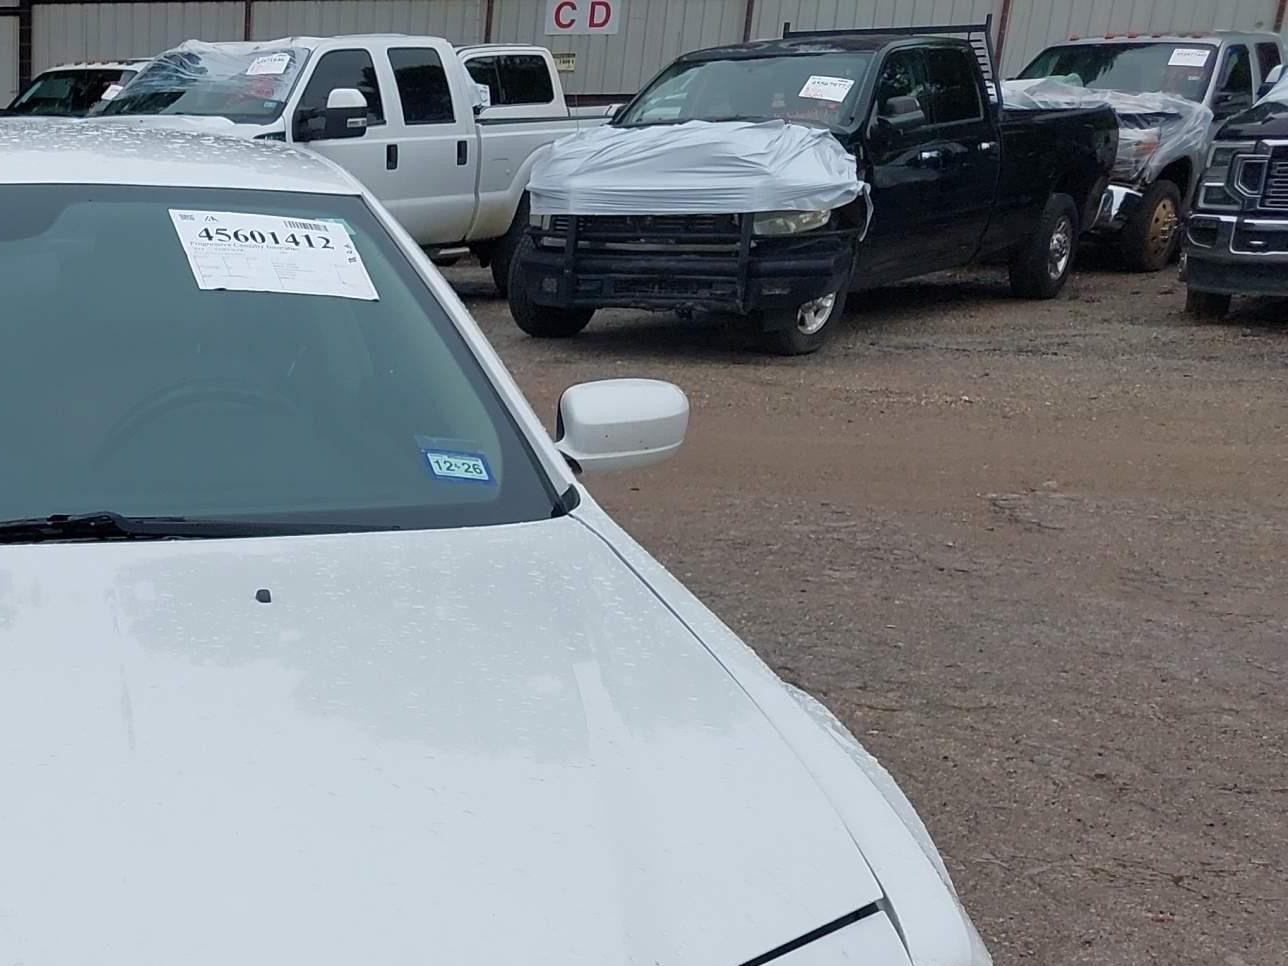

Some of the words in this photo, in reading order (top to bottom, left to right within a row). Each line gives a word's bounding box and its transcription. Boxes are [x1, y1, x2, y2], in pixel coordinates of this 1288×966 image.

[554, 1, 577, 29] C
[589, 1, 611, 28] D
[198, 227, 335, 250] 45601412
